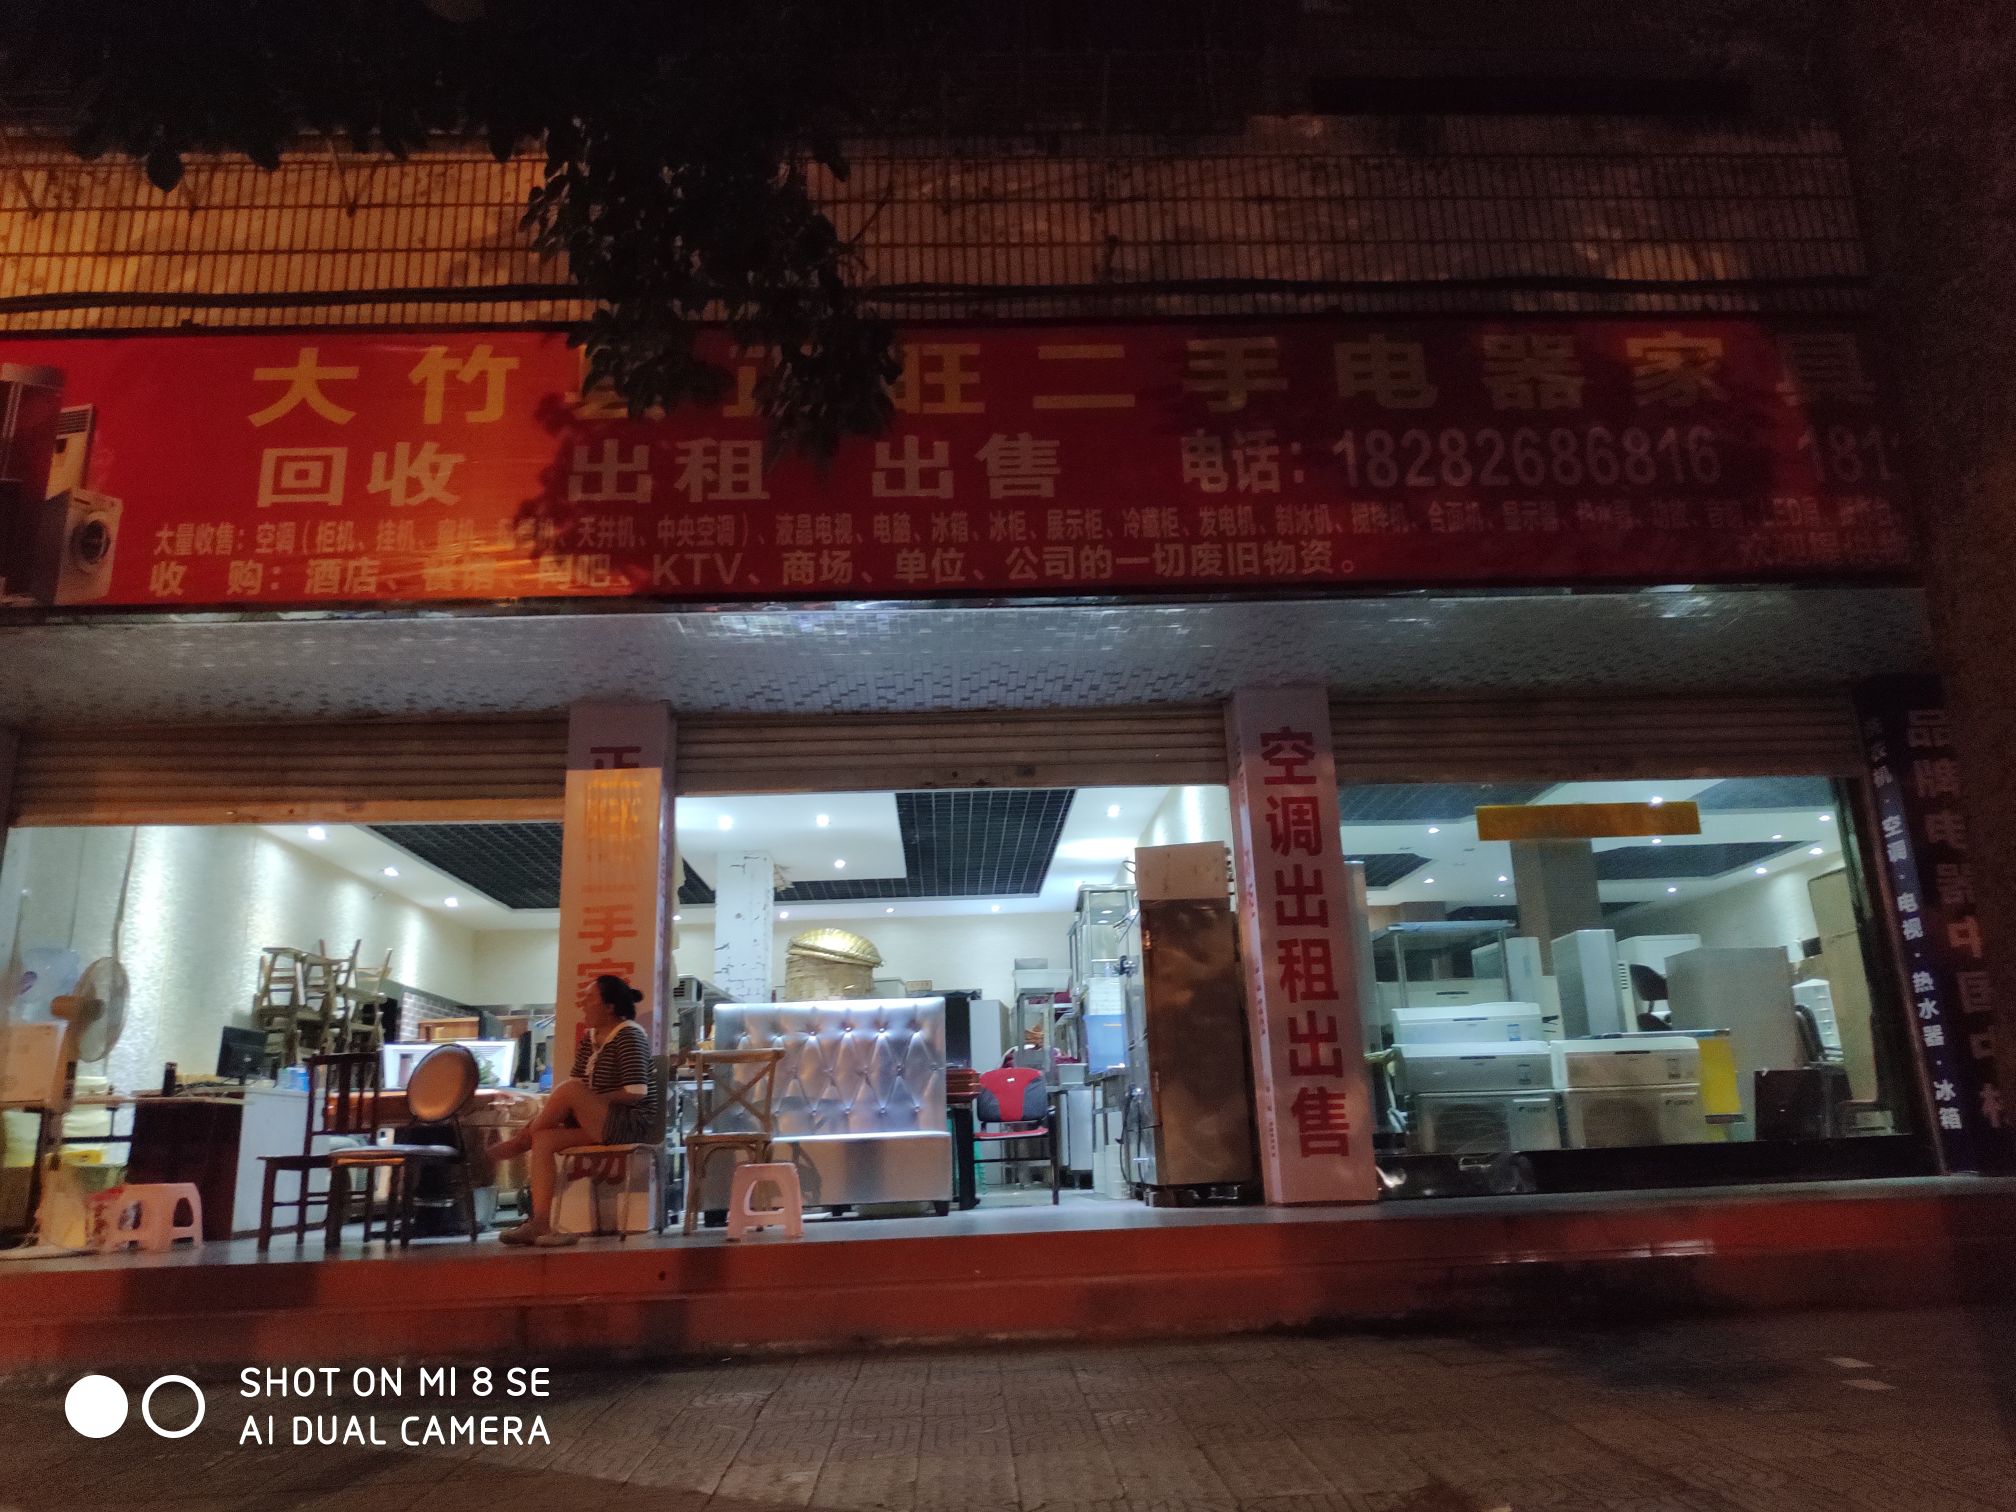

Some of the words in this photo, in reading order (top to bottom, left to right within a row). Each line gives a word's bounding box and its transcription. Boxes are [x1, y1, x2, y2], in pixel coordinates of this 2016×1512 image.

[256, 441, 466, 508] 回收
[567, 435, 770, 504] 出租
[871, 431, 1062, 500] 出售
[1259, 726, 1350, 1159] 空调出租出售
